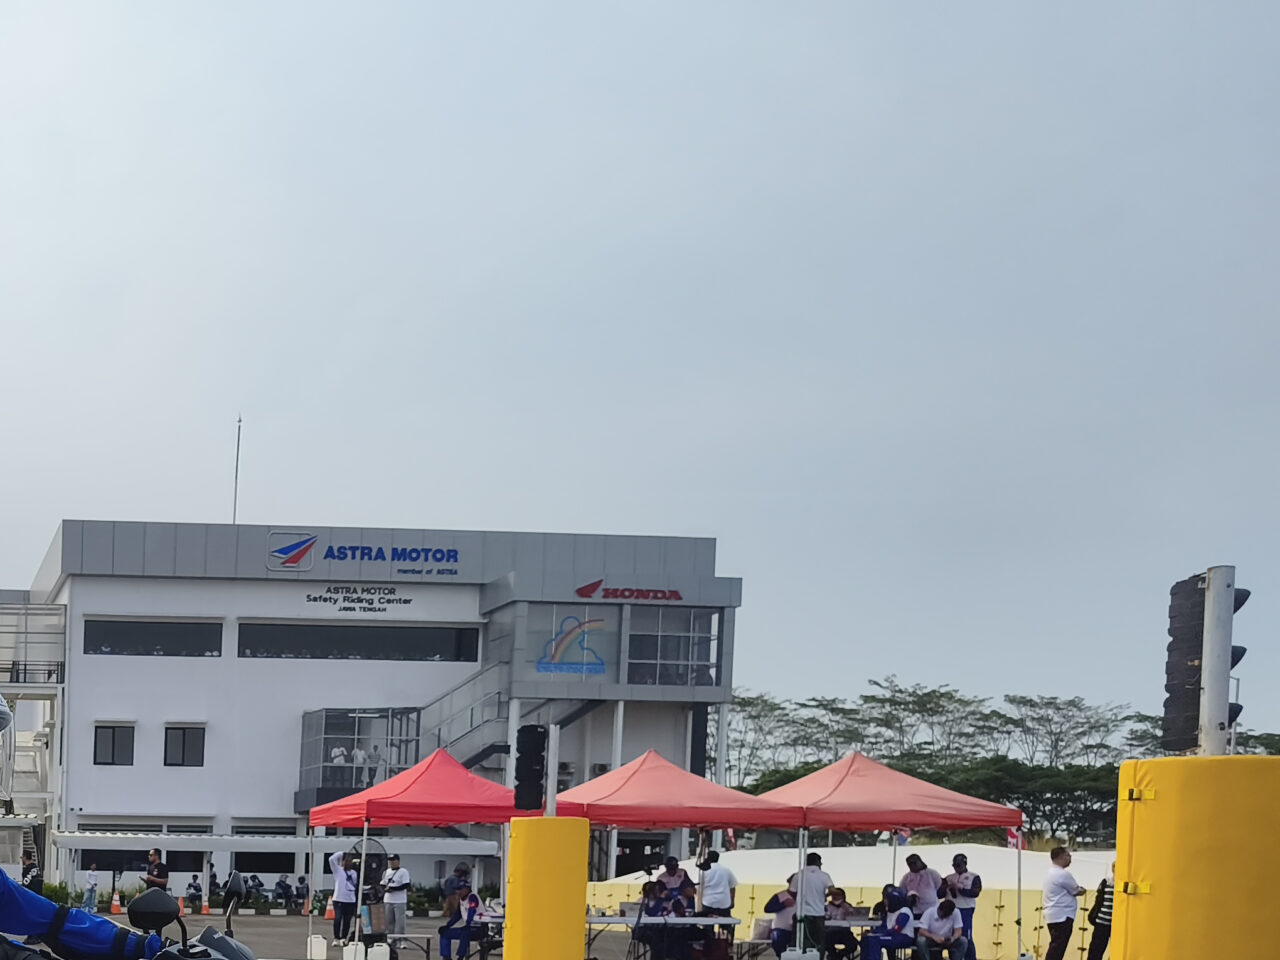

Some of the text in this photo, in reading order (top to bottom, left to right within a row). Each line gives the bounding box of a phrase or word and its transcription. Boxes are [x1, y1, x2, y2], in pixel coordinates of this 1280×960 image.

[323, 545, 459, 563] ASTRA MOTOR
[325, 586, 396, 596] ASTRA MOTOR
[602, 588, 683, 600] HONDA
[306, 594, 413, 605] Safety Riding Center
